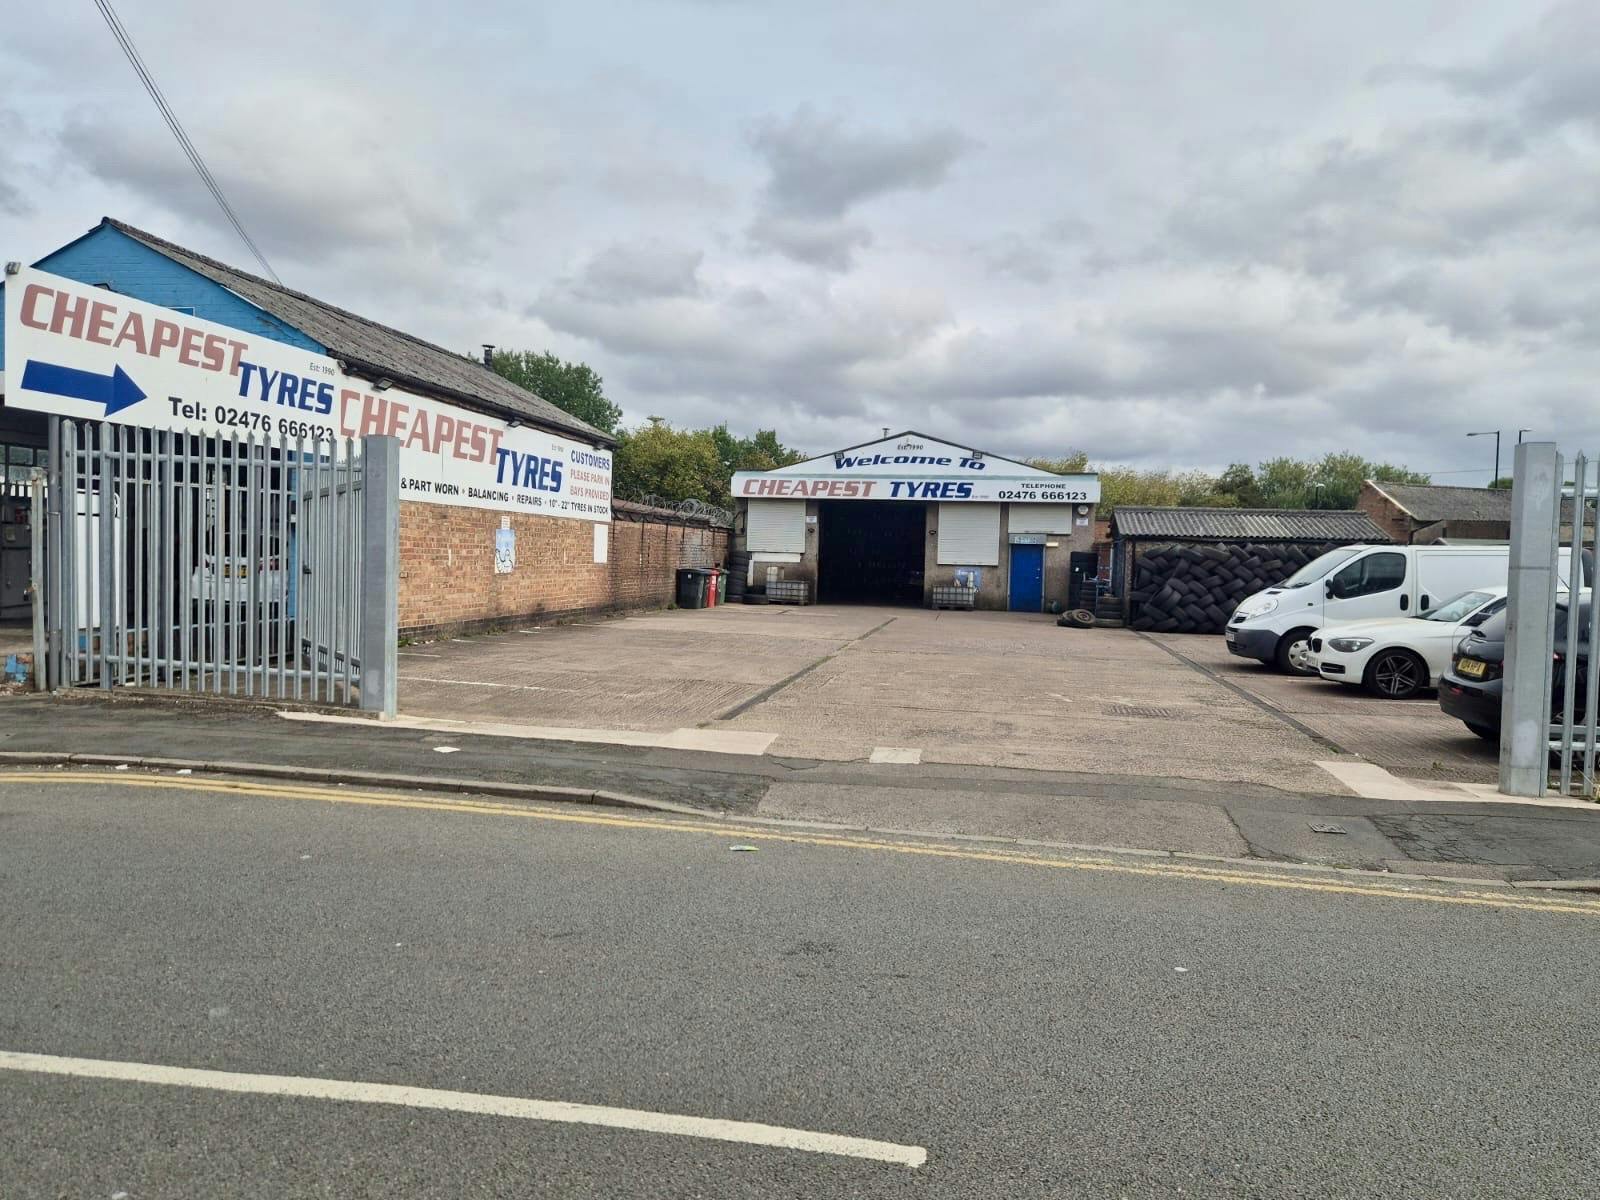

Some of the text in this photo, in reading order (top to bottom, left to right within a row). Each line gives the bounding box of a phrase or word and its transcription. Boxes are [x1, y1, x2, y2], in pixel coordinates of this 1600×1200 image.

[20, 284, 249, 376] CHEAPEST
[238, 361, 335, 415] TYRES
[168, 396, 334, 444] Tel: 02476 666123
[340, 389, 504, 466] CHEAPEST
[496, 447, 563, 493] TYRES
[571, 450, 610, 471] CUSTOMERS
[835, 455, 985, 471] Welcome To
[570, 469, 590, 482] PLEASE
[590, 473, 604, 485] PARK
[743, 479, 974, 498] CHEAPEST TYRES
[401, 478, 407, 489] &
[409, 479, 432, 492] PART
[434, 482, 459, 496] WORN
[468, 487, 509, 502] BALANCING
[516, 494, 542, 507] REPAIRS
[571, 502, 586, 512] TYRES
[587, 504, 593, 513] IN
[593, 505, 608, 515] STOCK
[570, 485, 610, 501] BAYS PROVIDED
[999, 491, 1036, 500] 02476
[1041, 491, 1087, 500] 666123
